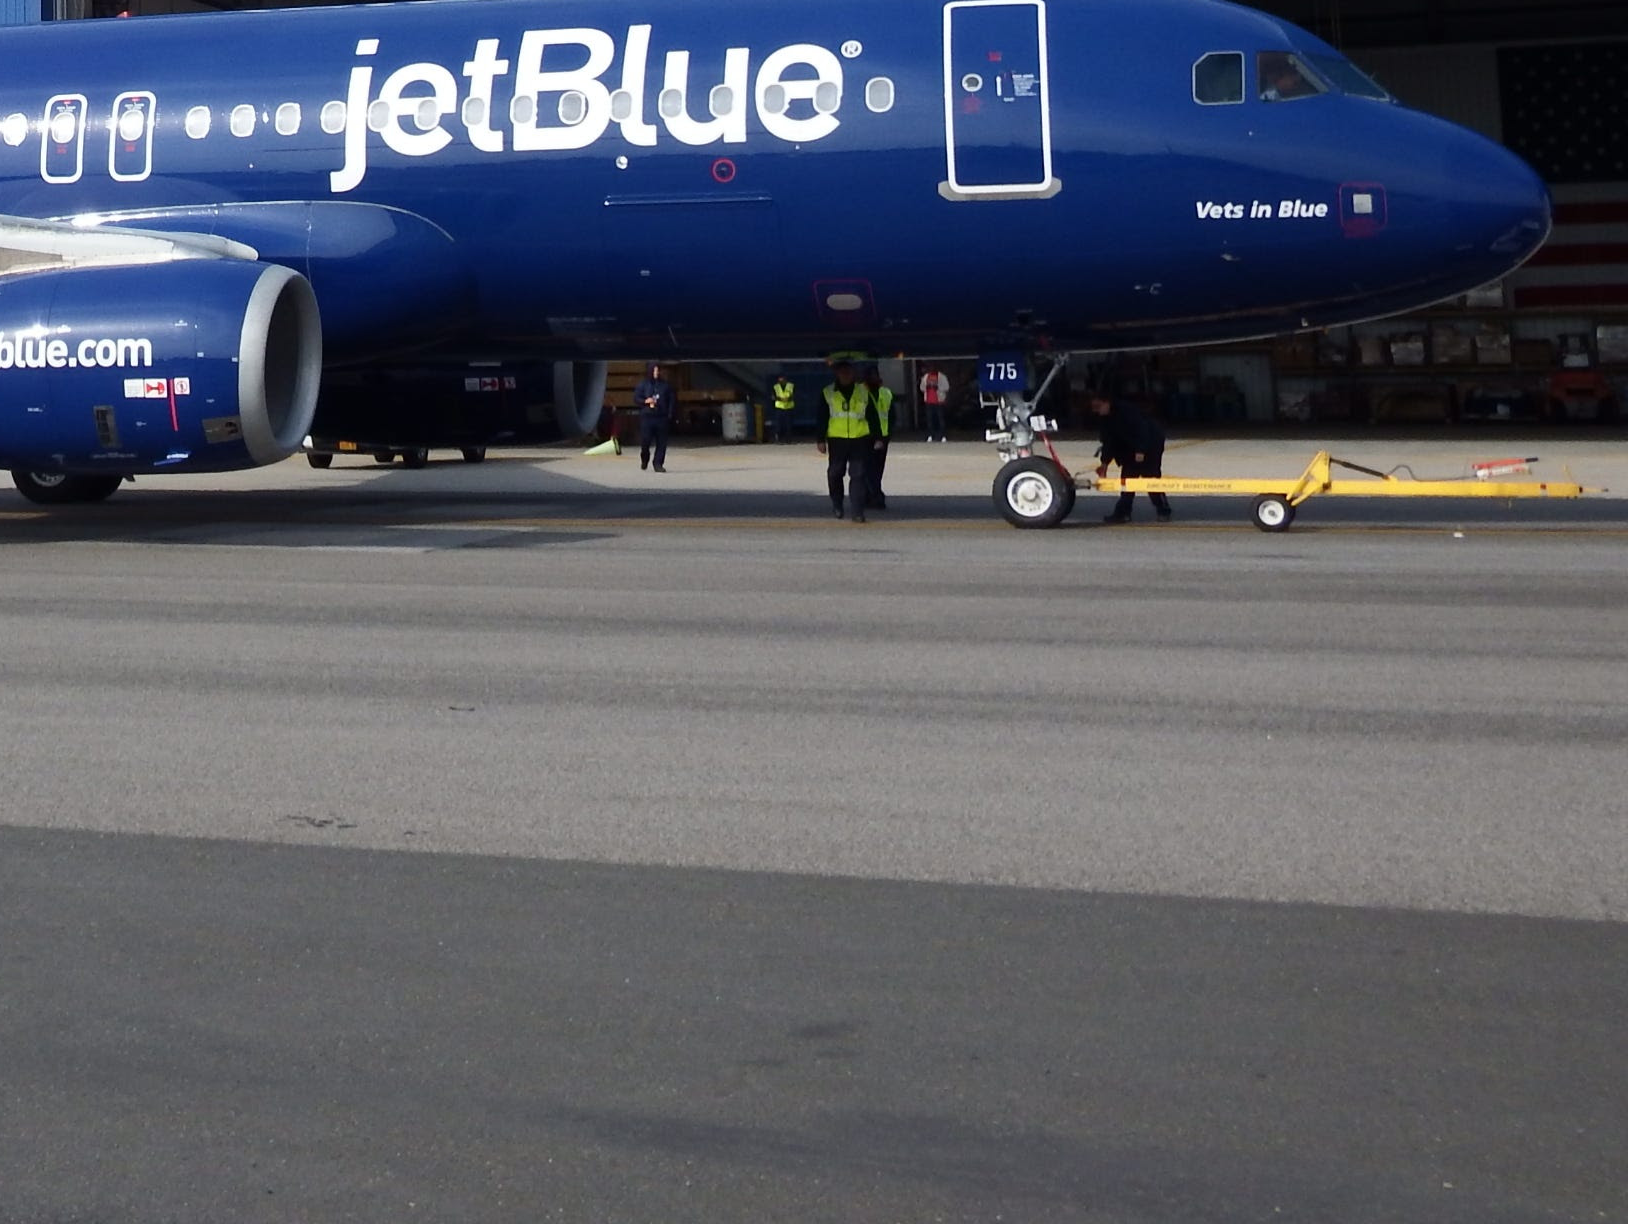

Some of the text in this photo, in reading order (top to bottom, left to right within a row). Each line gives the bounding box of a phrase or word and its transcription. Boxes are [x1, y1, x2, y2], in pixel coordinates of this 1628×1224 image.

[1195, 198, 1329, 219] Vets in Blue
[985, 362, 1018, 381] 775
